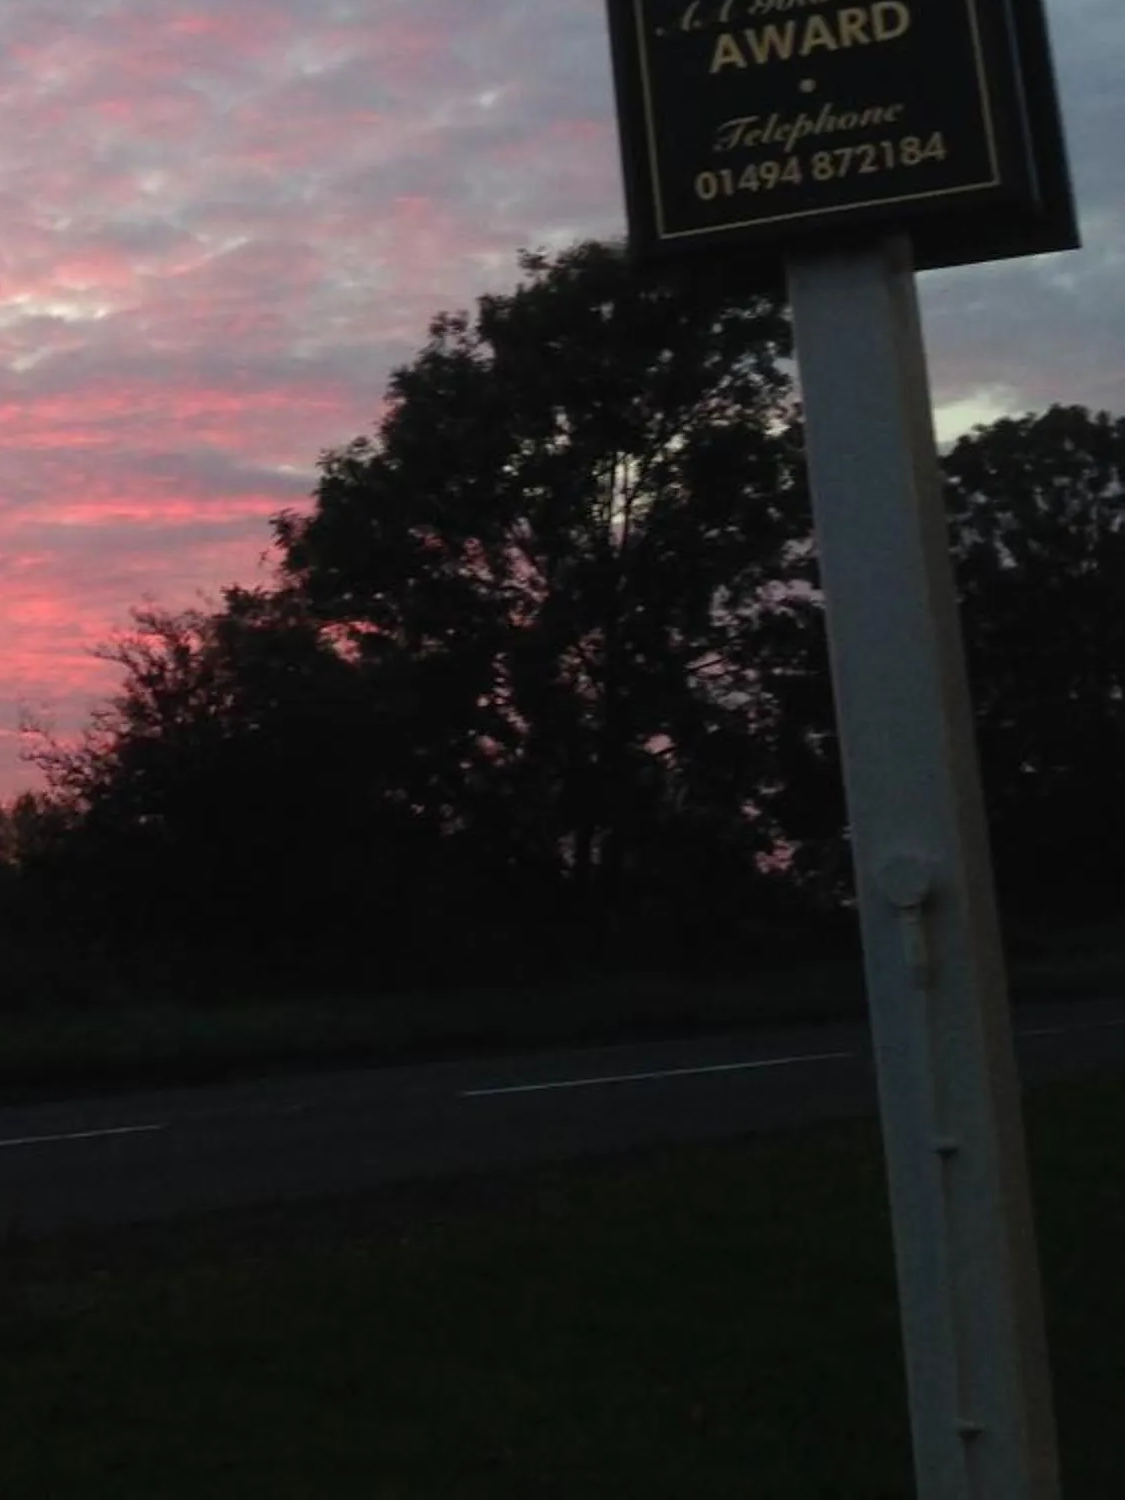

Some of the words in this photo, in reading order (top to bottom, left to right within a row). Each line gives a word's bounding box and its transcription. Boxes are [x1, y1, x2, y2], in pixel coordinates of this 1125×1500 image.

[709, 0, 912, 74] AWARD
[713, 102, 905, 153] Telephone
[694, 157, 804, 200] 01494
[811, 132, 947, 182] 872184
